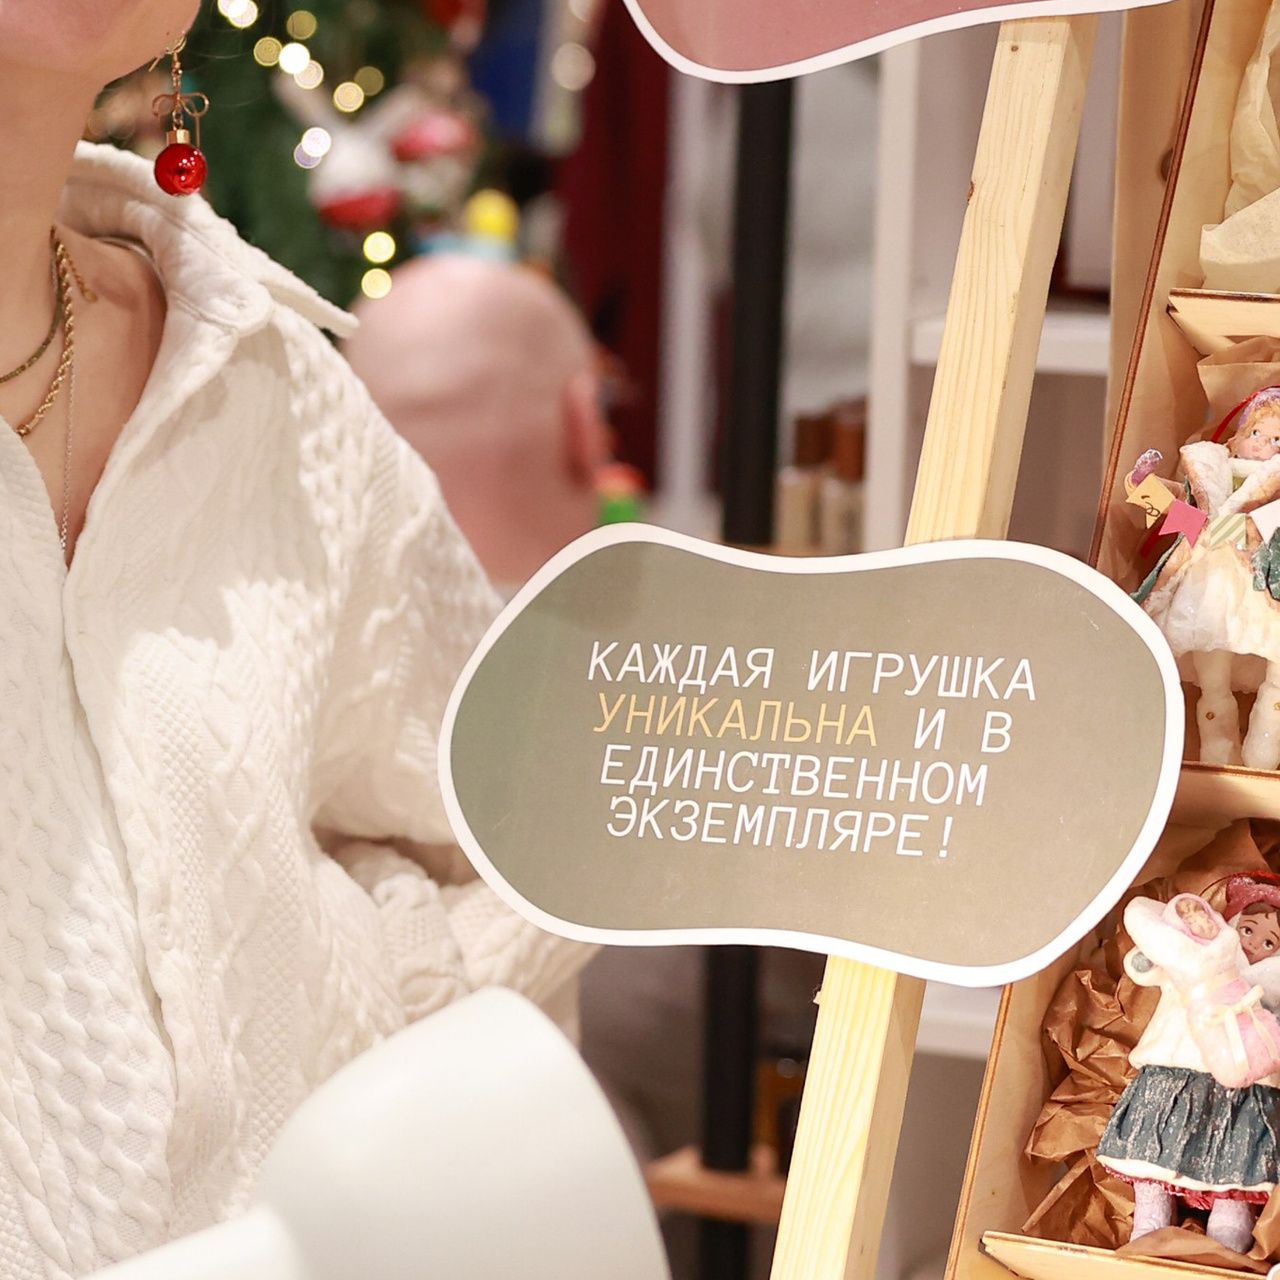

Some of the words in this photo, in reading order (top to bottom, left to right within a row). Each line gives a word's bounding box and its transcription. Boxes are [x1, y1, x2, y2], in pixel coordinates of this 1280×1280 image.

[587, 640, 775, 695] КАЖДАЯ
[807, 649, 1036, 701] ИГРУШКА
[593, 692, 877, 747] УНИКАЛЬНА
[913, 707, 946, 750] И
[980, 710, 1013, 753] В
[600, 743, 988, 807] ЕДИНСТВЕННОМ
[606, 795, 954, 859] ЭКЗЕМПЛЯРЕ!
